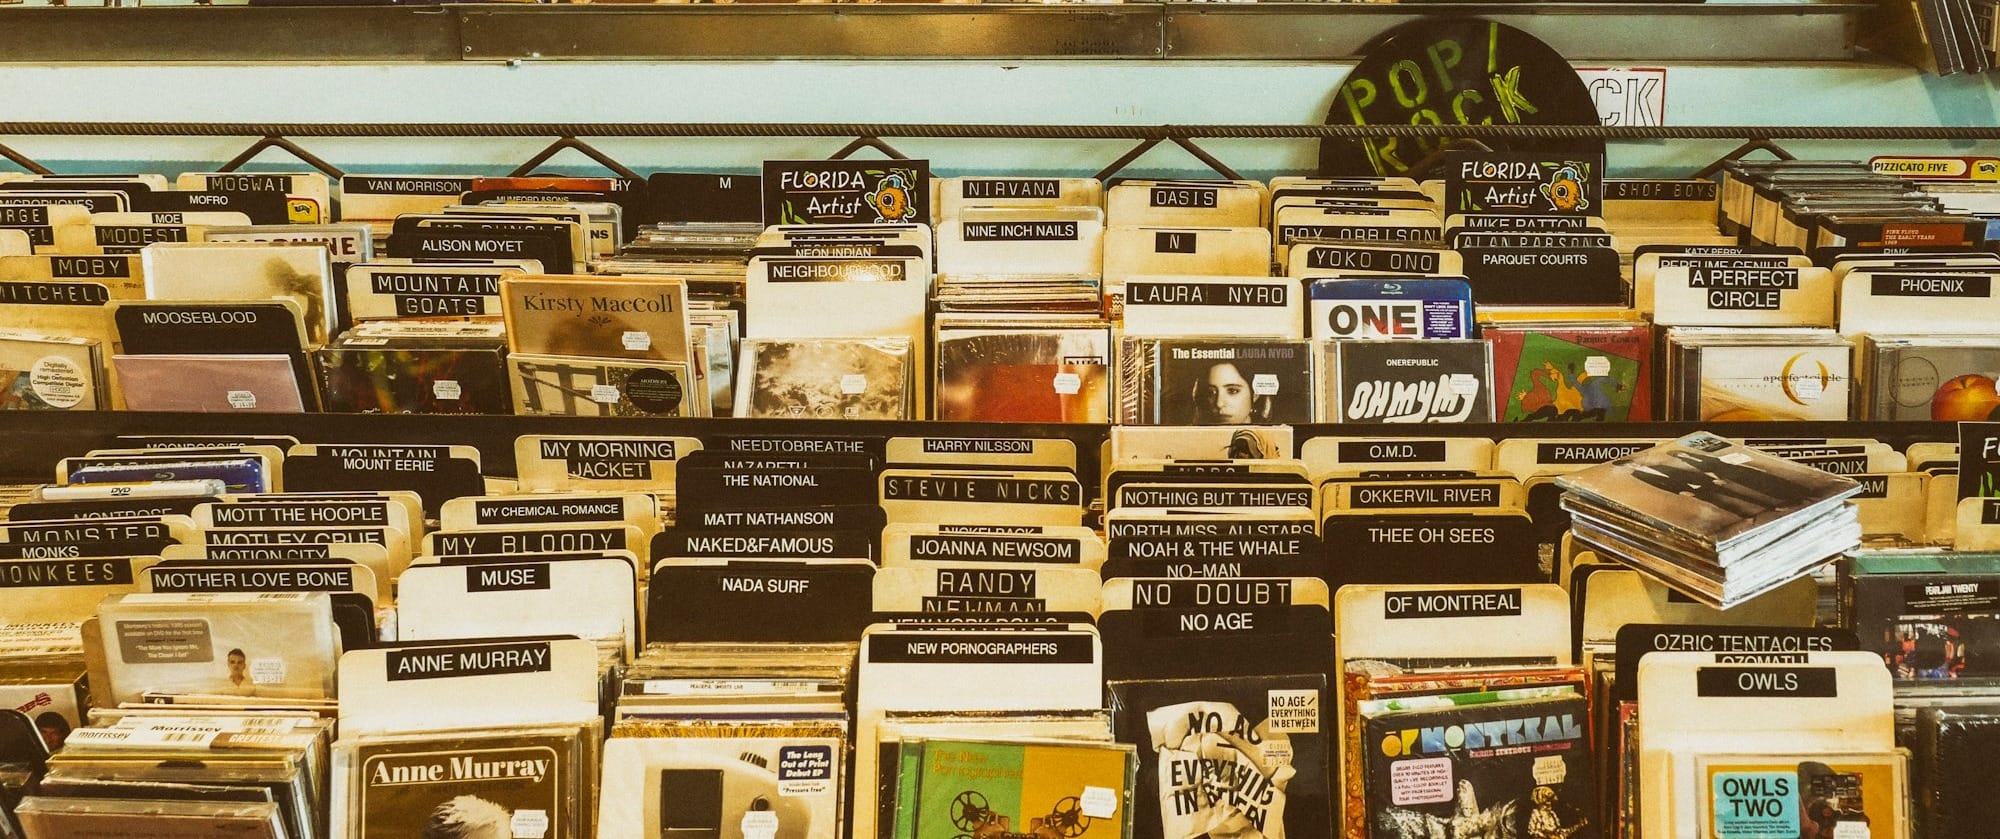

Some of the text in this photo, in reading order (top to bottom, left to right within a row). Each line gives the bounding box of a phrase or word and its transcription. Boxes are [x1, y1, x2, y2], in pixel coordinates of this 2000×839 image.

[1344, 39, 1464, 127] POP
[1461, 161, 1541, 181] FLORIDA
[1873, 162, 1948, 173] PIZZICATO FIVE
[212, 177, 285, 192] MOGWAI
[368, 180, 462, 192] VAN MORRISON
[719, 177, 732, 189] M
[781, 170, 866, 190] FLORIDA
[969, 182, 1056, 196] NIRVANA
[1484, 186, 1537, 205] Artist
[1673, 183, 1716, 197] BOYS
[190, 195, 228, 205] MOFRO
[806, 195, 862, 214] Artist
[1156, 191, 1215, 206] OASIS
[155, 213, 180, 224] MOE
[101, 228, 181, 243] MODEST
[966, 225, 1074, 237] NINE INCH NAILS
[422, 239, 524, 253] ALISON MOYET
[1169, 235, 1180, 249] N
[58, 259, 120, 275] MOBY
[1316, 250, 1432, 271] YOKO ONO
[1482, 255, 1588, 265] PARQUET COURTS
[378, 275, 498, 294] MOUNTAIN
[1692, 270, 1797, 287] A PERFECT
[1901, 279, 1964, 292] PHOENIX
[1134, 286, 1284, 304] LAURA NYRO
[1710, 290, 1777, 307] CIRCLE
[406, 297, 478, 314] GOATS
[524, 292, 673, 317] Kirsty MacColl
[143, 311, 257, 324] MOOSEBLOOD
[1328, 305, 1418, 335] ONE
[1172, 348, 1189, 359] The
[1191, 347, 1235, 360] Essential
[1268, 348, 1294, 359] NYRO
[1386, 359, 1439, 367] ONEREPUBLIC
[543, 442, 672, 458] MY MORNING
[730, 440, 864, 453] NEEDTOBREATHE
[927, 440, 1030, 453] HARRY NILSSON
[1369, 445, 1417, 459] O.M.D.
[344, 458, 434, 472] MOUNT EERIE
[573, 462, 646, 478] JACKET
[723, 475, 818, 487] THE NATIONAL
[110, 487, 131, 496] DVD
[888, 479, 1070, 500] STEVIE NICKS
[1359, 488, 1491, 504] OKKERVIL RIVER
[1125, 491, 1308, 506] NOTHING BUT THIEVES
[217, 507, 382, 522] MOTT THE HOOPLE
[481, 504, 618, 517] MY CHEMICAL ROMANCE
[704, 512, 834, 526] MATT NATHANSON
[1368, 528, 1495, 544] THEE OH SEES
[442, 533, 613, 555] MY BLOODY
[688, 537, 833, 554] NAKED&FAMOUS
[916, 539, 1071, 558] JOANNA NEWSOM
[1129, 540, 1300, 557] NOAH & THE WHALE
[22, 545, 80, 559] MONKS
[155, 571, 349, 588] MOTHER LOVE BONE
[481, 569, 535, 587] MUSE
[722, 578, 809, 593] NADA SURF
[939, 572, 1033, 593] RANDY
[1136, 583, 1289, 605] NO DOUBT
[1387, 594, 1519, 613] OF MONTREAL
[1180, 613, 1254, 631] NO AGE
[908, 642, 1057, 655] NEW PORNOGRAPHERS
[1654, 634, 1833, 652] OZRIC TENTACLES
[398, 649, 547, 674] ANNE MURRAY
[1738, 672, 1799, 690] OWLS
[1271, 696, 1306, 707] NO AGE
[1271, 709, 1316, 718] EVERYTHING
[1188, 712, 1223, 734] NO
[1271, 718, 1316, 730] IN BETWEEN
[786, 751, 824, 761] The Long
[809, 759, 829, 768] Print
[372, 756, 551, 784] Anne Murray
[812, 769, 824, 777] EP
[1722, 777, 1790, 797] OWLS
[1174, 790, 1199, 816] IN
[1729, 798, 1783, 817] TWO
